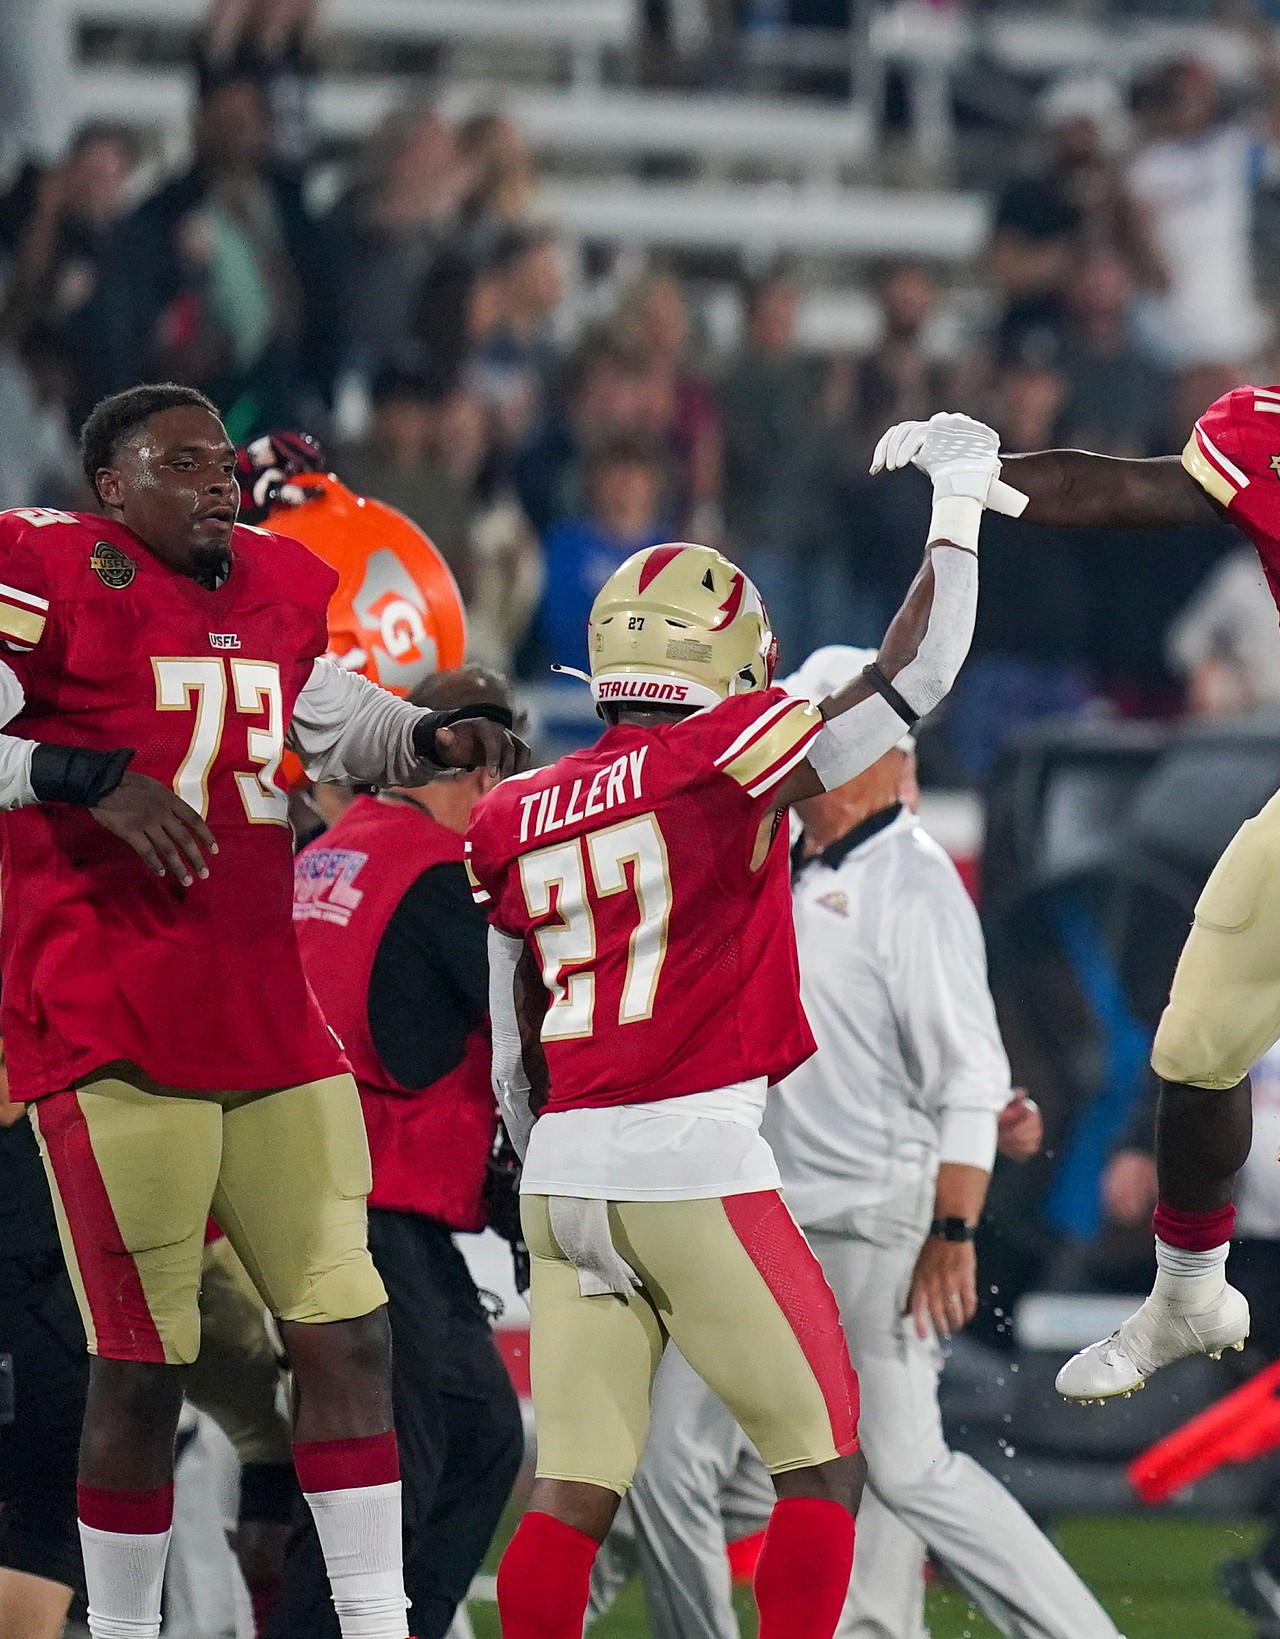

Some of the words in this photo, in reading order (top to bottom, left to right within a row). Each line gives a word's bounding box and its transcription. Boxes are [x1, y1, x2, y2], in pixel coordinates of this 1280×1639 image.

[209, 633, 241, 648] USFL
[628, 617, 645, 630] 27
[598, 681, 688, 701] STALLIONS
[150, 656, 289, 828] 73
[519, 745, 649, 843] TILLERY
[518, 811, 673, 1042] 27
